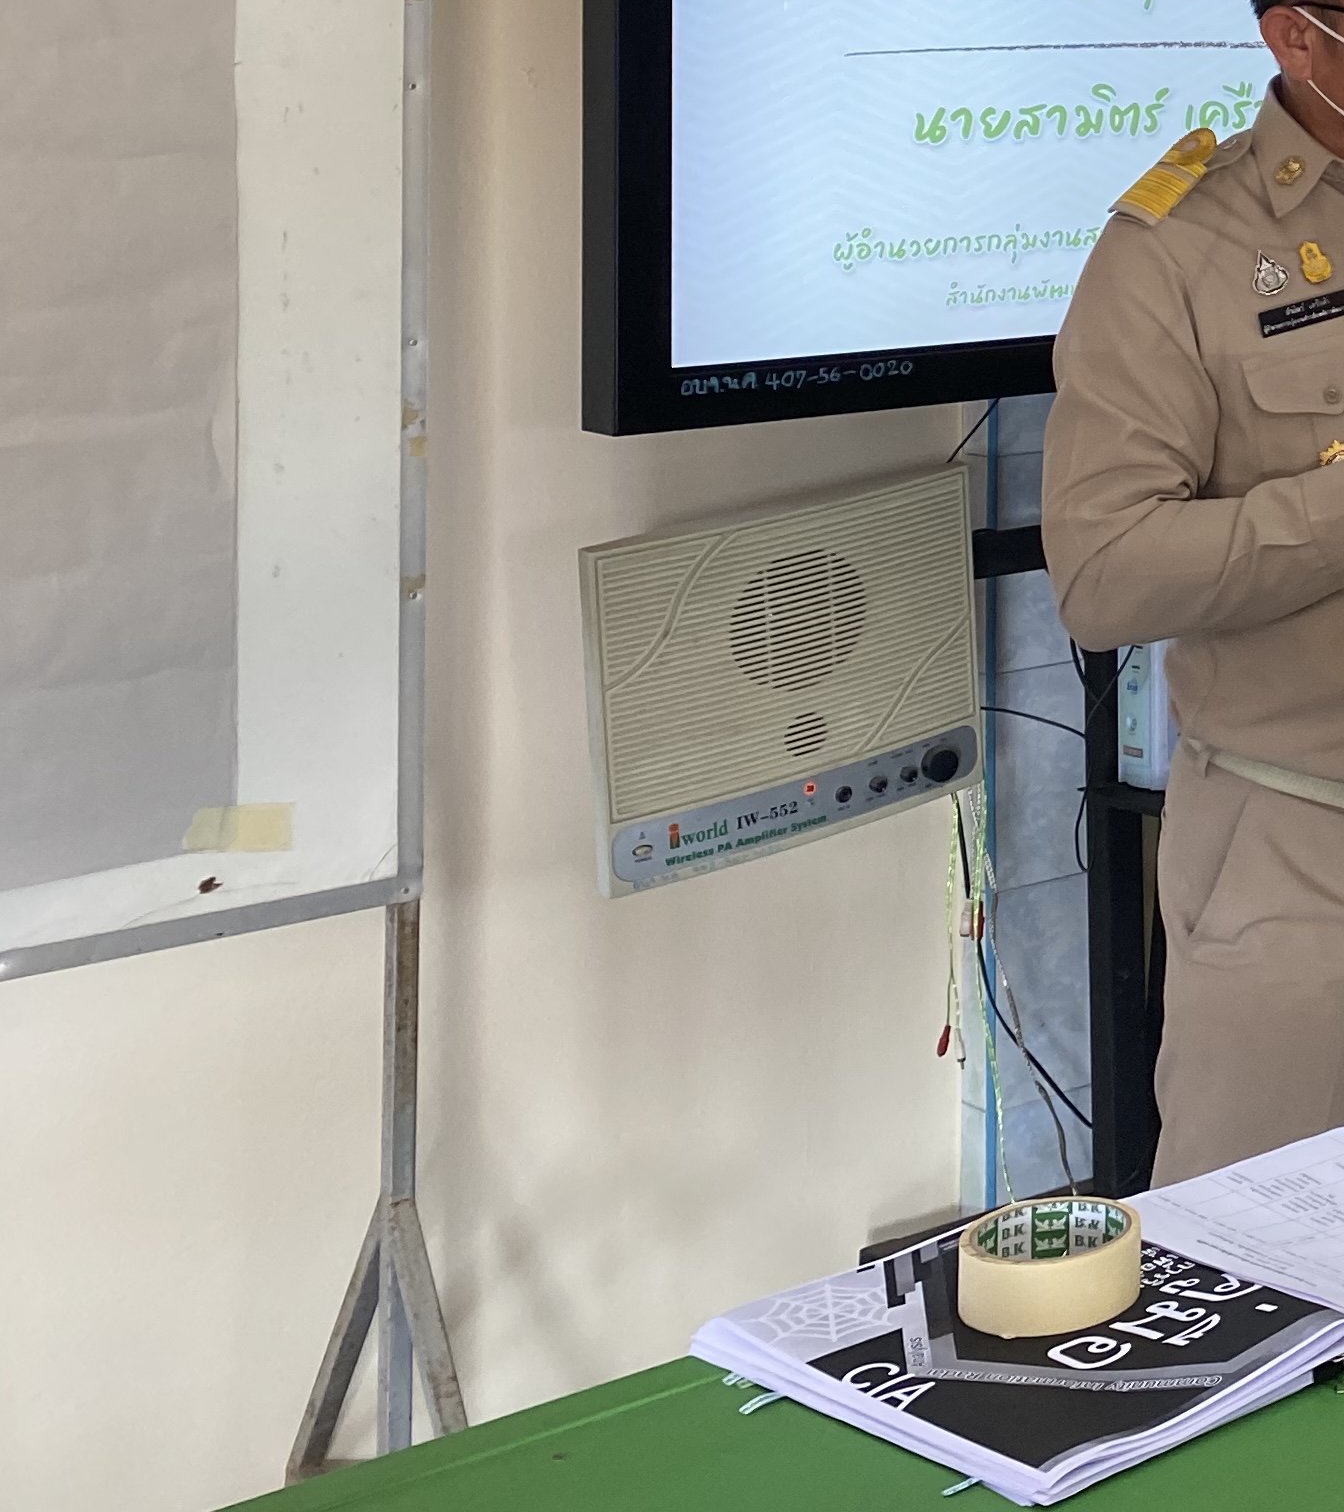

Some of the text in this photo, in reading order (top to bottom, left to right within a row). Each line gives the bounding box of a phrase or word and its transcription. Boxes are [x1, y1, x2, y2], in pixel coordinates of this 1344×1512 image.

[765, 359, 914, 391] 407-56-0020
[736, 800, 799, 831] IW-552
[665, 814, 828, 867] Wireless PA Amplifier System
[840, 1361, 937, 1411] CIA
[1104, 1374, 1223, 1393] Community
